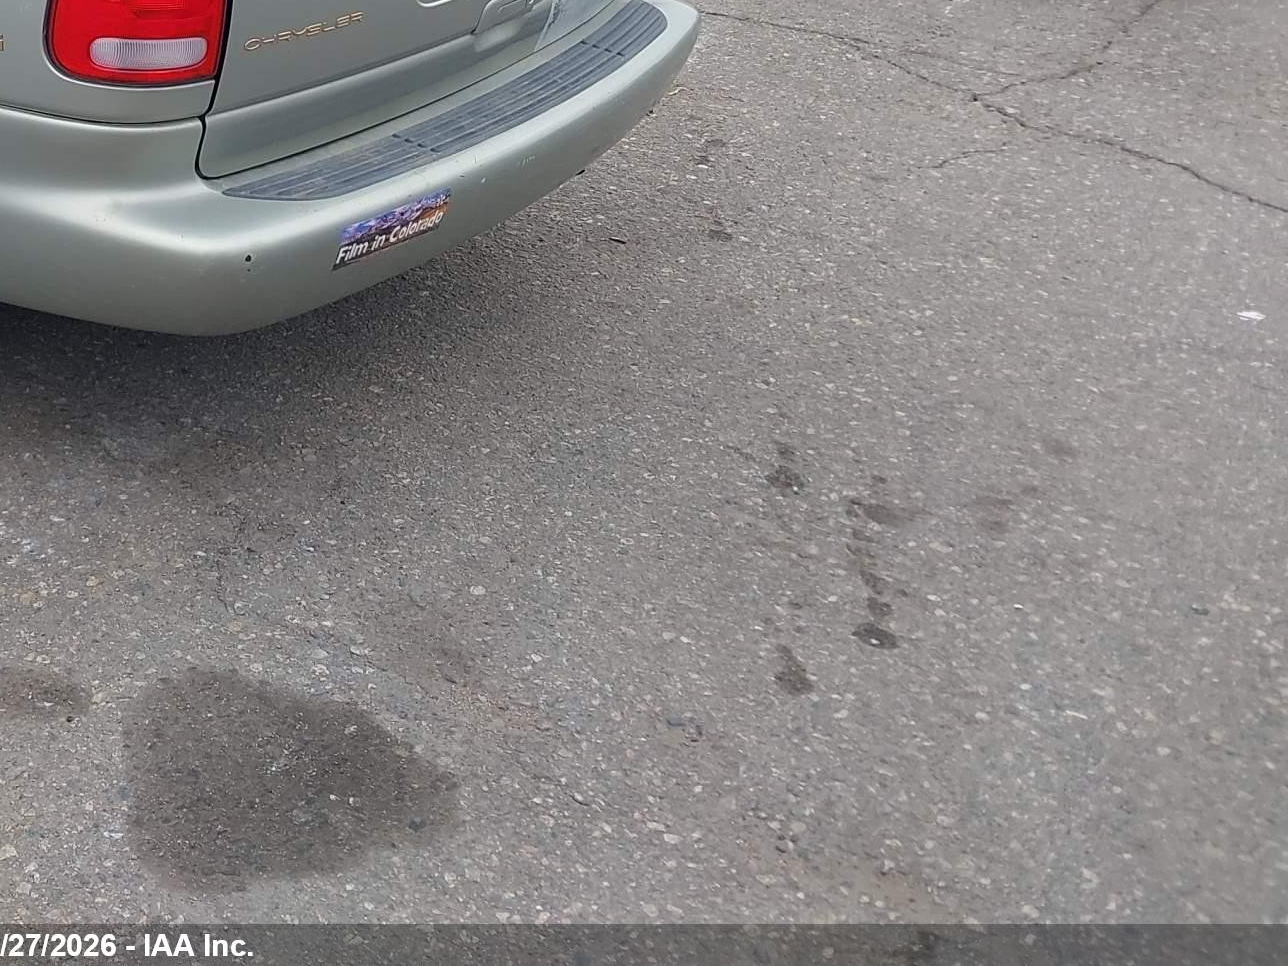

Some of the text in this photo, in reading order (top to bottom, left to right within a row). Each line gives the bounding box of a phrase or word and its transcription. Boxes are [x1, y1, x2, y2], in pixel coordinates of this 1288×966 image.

[244, 11, 364, 51] CHRYSLER
[335, 210, 445, 265] Film in Colorado
